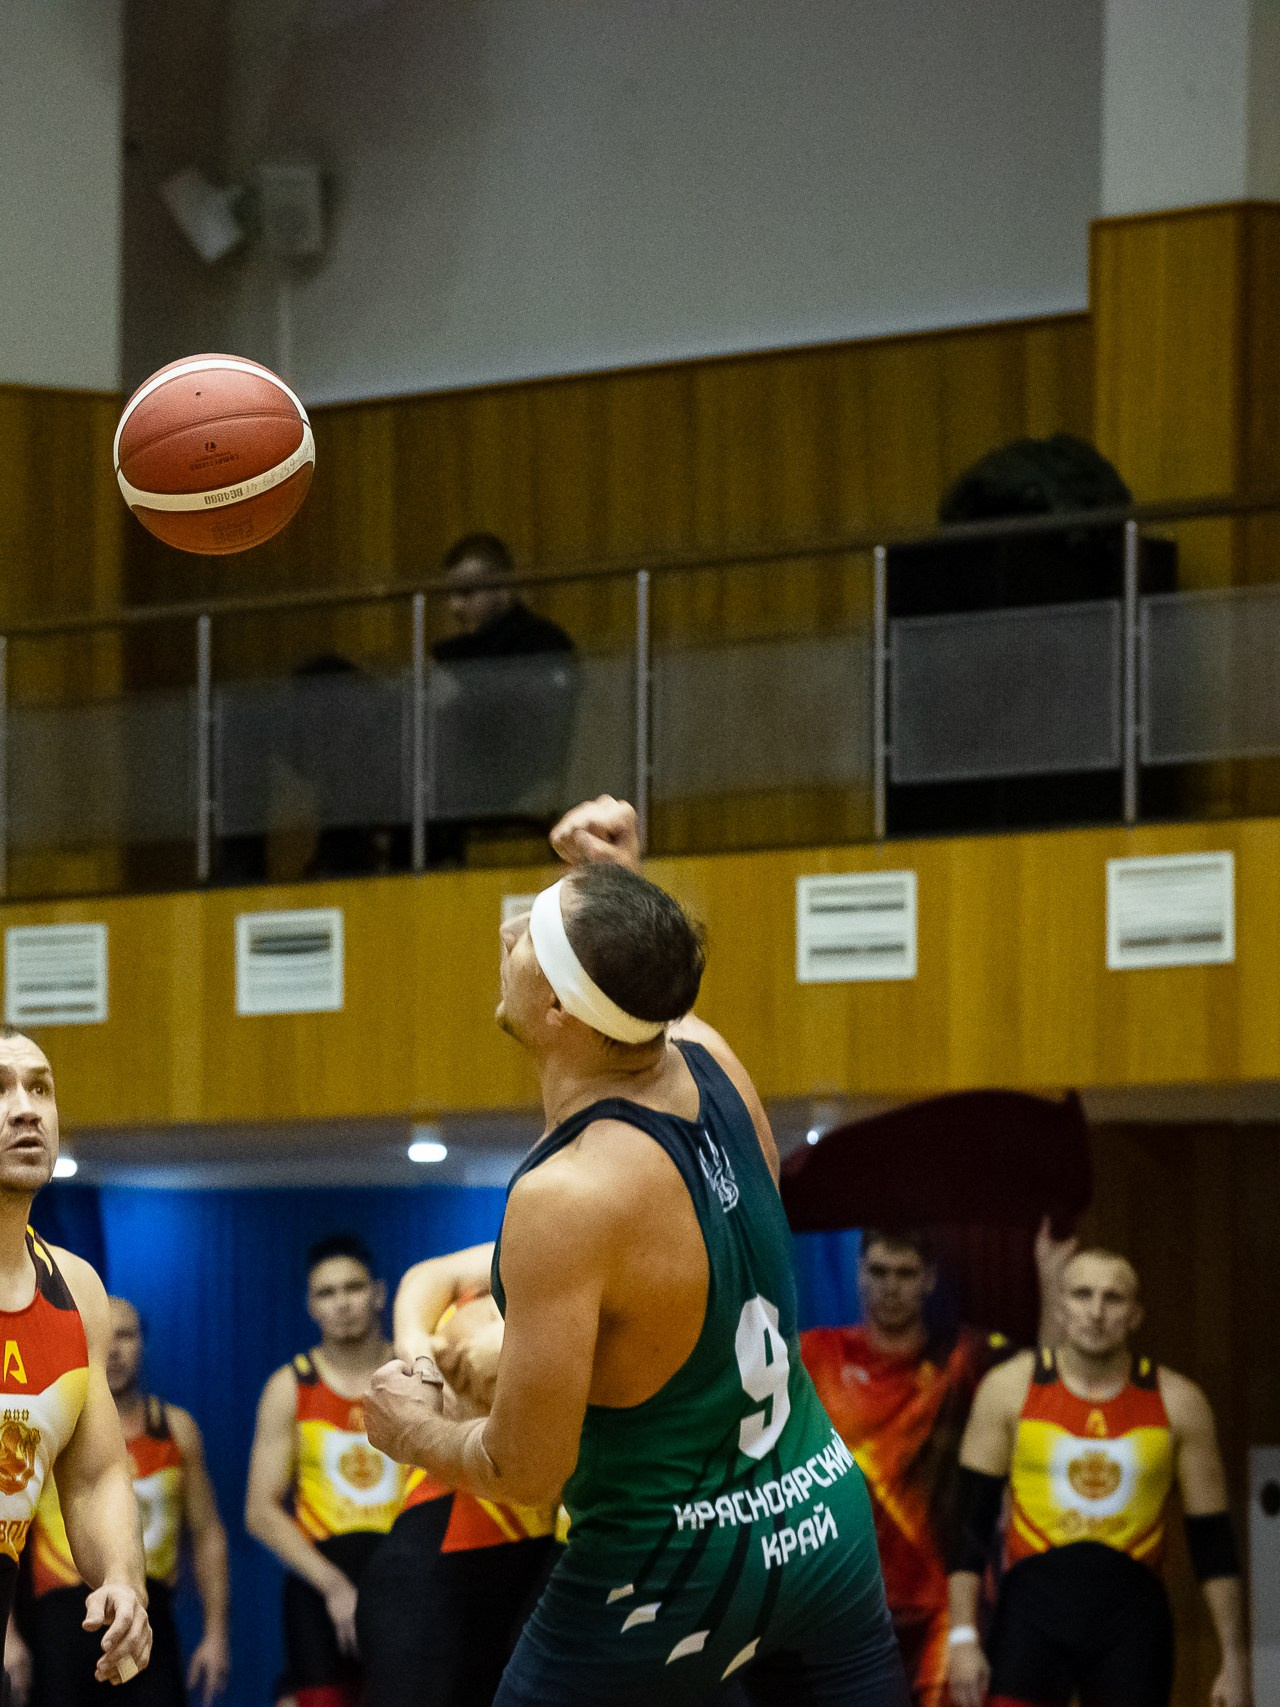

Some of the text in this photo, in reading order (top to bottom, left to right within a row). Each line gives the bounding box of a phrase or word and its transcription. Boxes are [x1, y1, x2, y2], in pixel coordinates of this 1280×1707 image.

[735, 1294, 791, 1460] 9
[673, 1427, 855, 1531] КРАСНОЯРСКИЙ
[761, 1502, 839, 1570] КРАЙ
